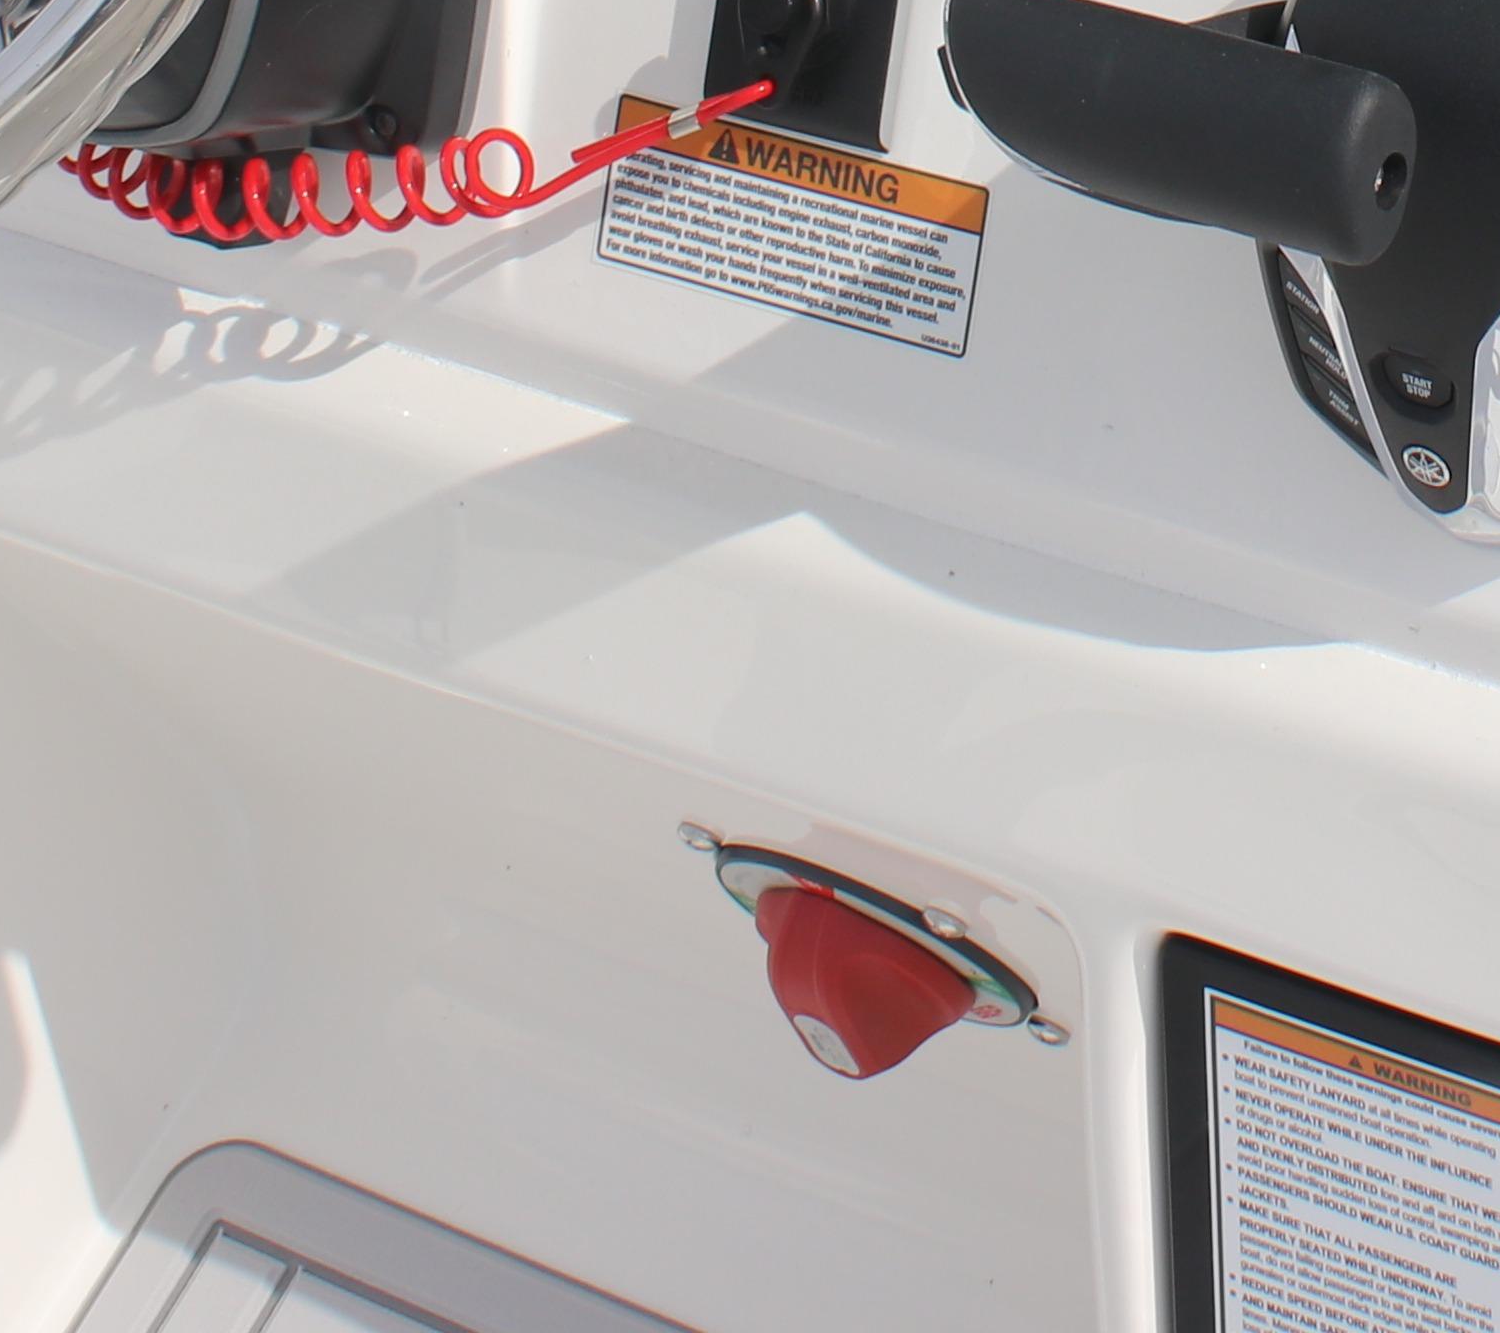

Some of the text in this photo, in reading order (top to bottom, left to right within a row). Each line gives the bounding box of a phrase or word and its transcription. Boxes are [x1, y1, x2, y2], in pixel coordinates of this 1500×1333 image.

[744, 136, 901, 205] WARNING
[616, 163, 650, 183] expose
[650, 172, 670, 188] you
[682, 178, 731, 202] chemicals
[731, 192, 777, 217] including
[776, 204, 811, 226] engine
[811, 213, 854, 238] exhaust,
[854, 225, 890, 244] carbon
[889, 234, 943, 262] monoxide,
[1402, 371, 1433, 389] START
[1406, 383, 1431, 399] STOP
[1233, 1054, 1496, 1161] WEAR SAFETY LANYARD at all times while operating
[1372, 1061, 1472, 1109] WARNING
[1234, 1088, 1492, 1190] NEVER OPERATE WHILE UNDER THE INFLUENCE
